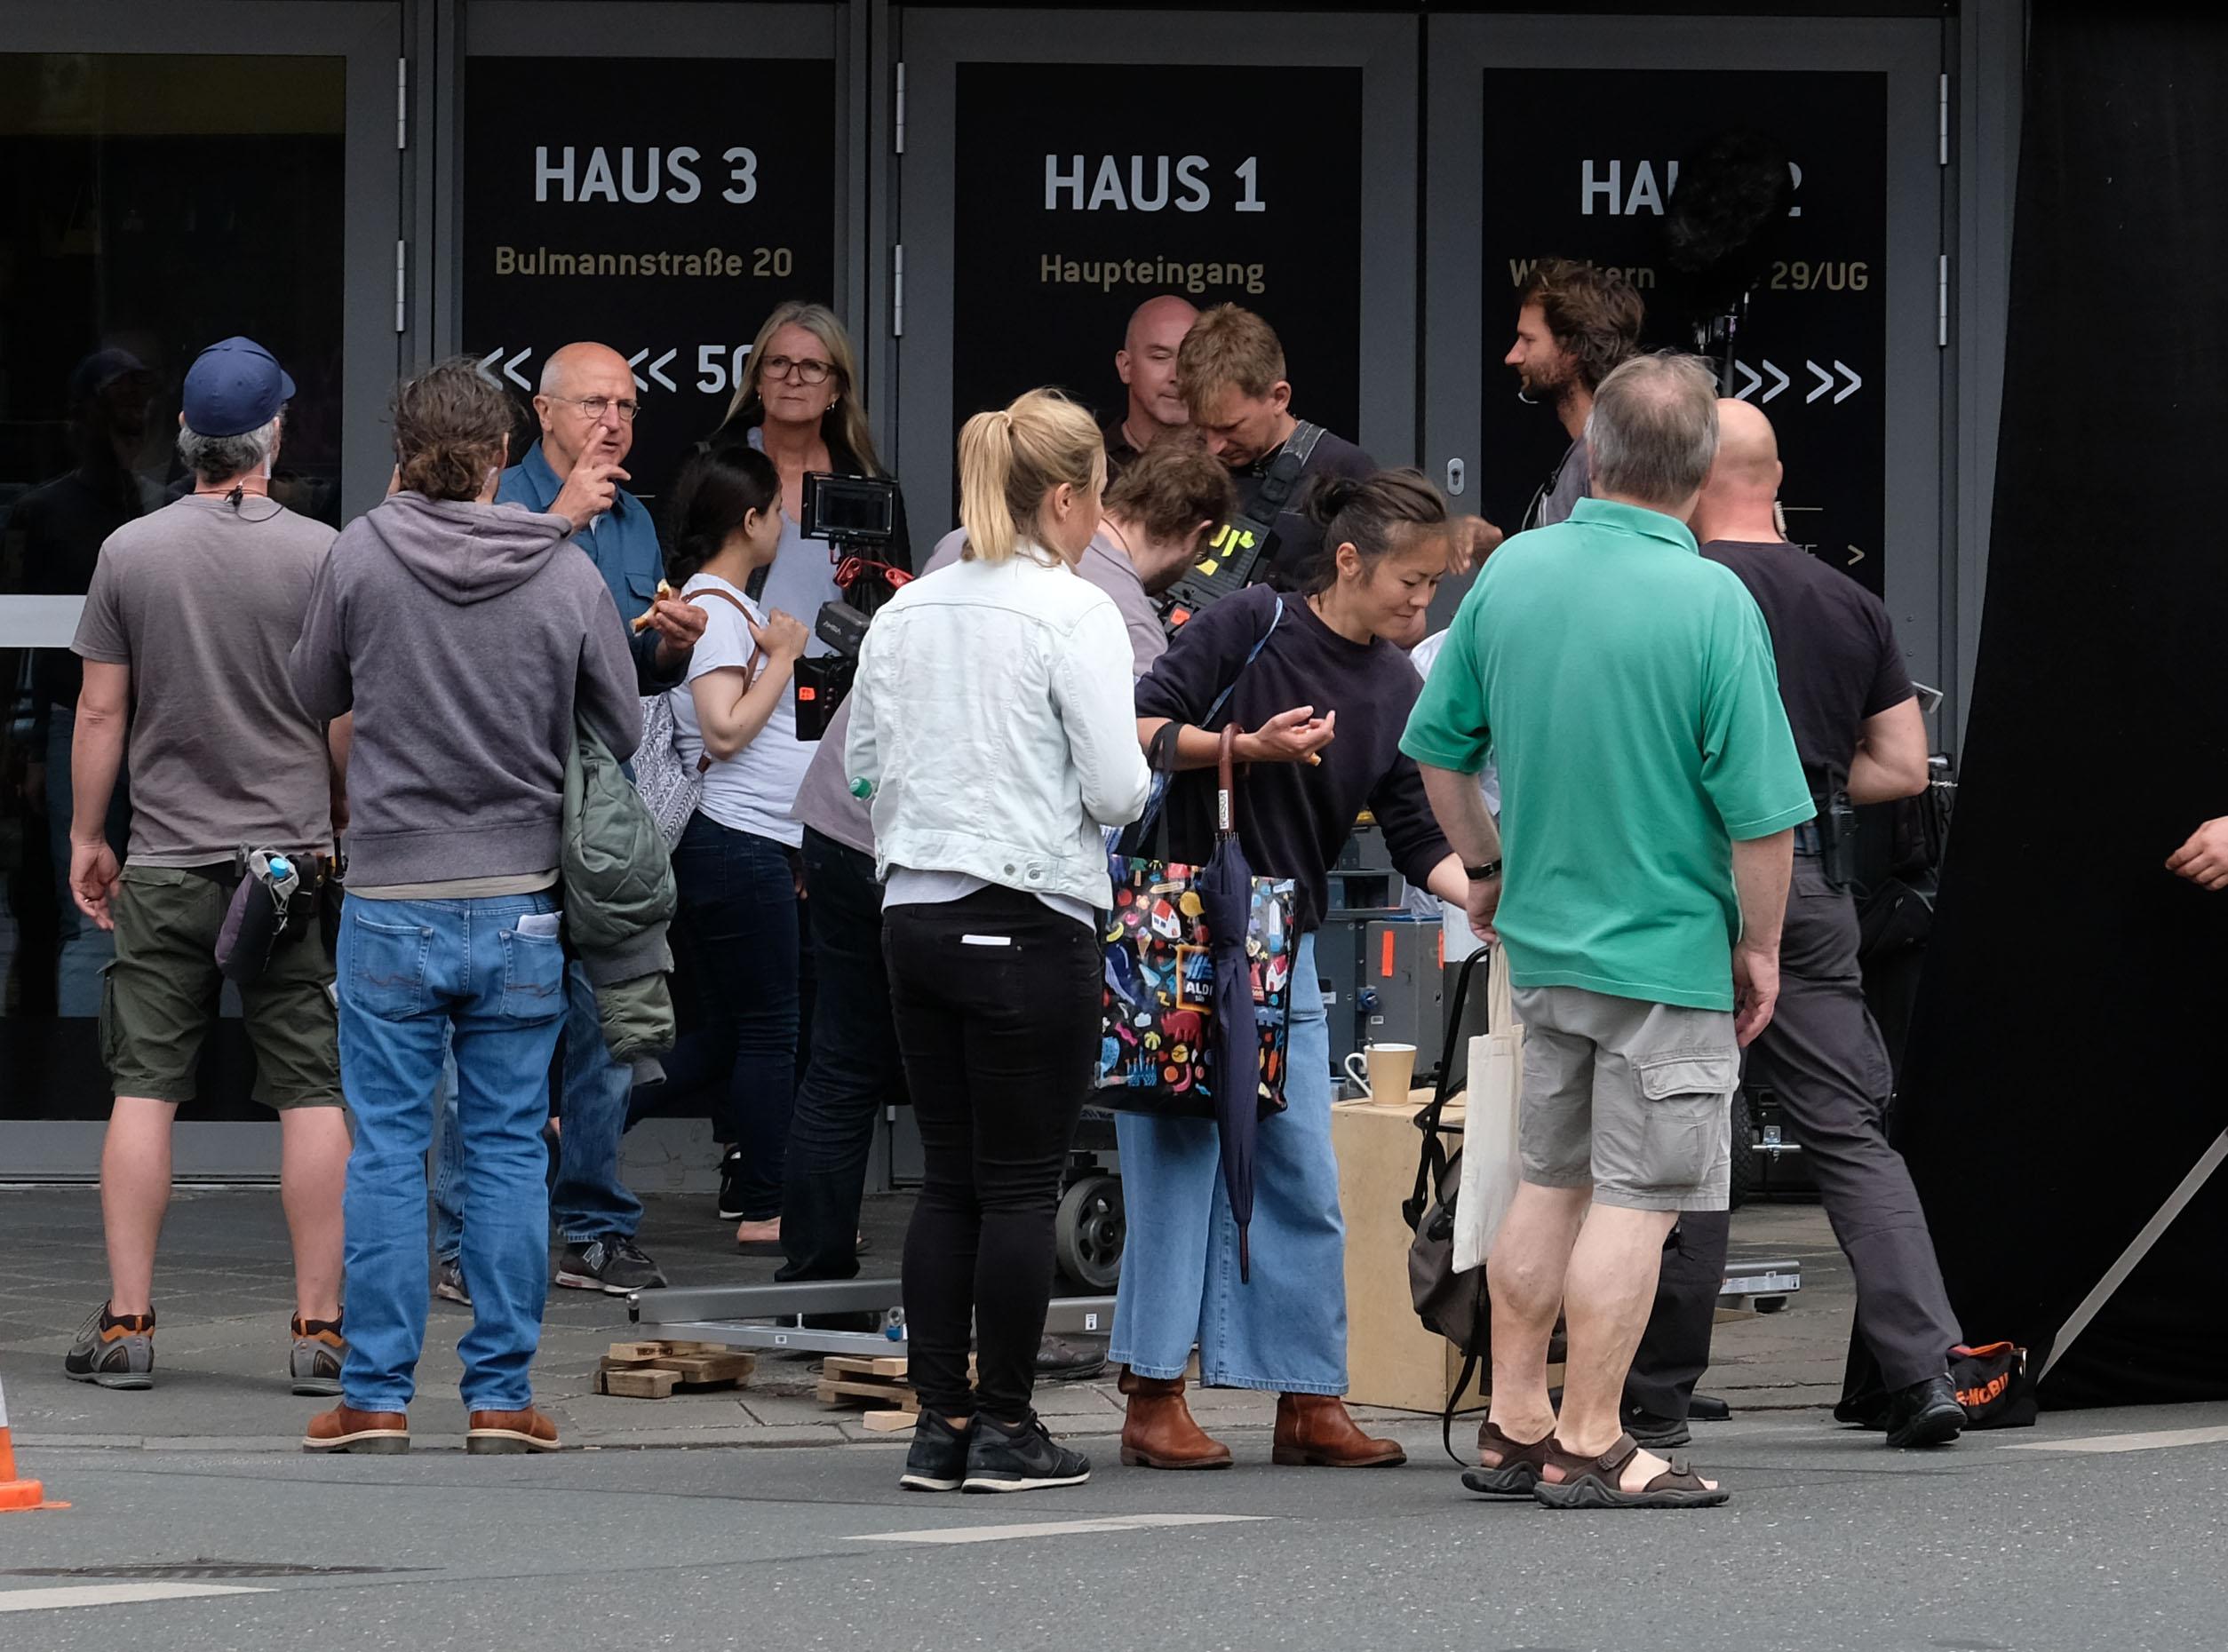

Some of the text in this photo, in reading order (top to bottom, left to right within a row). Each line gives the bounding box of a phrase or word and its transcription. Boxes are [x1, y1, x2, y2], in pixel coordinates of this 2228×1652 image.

[536, 147, 757, 203] HAUS 3
[1046, 155, 1265, 211] HAUS 1
[497, 247, 792, 276] Bulmannstraße 20
[1042, 255, 1265, 293] Haupteingang
[1771, 262, 1867, 290] 29/UG
[1185, 981, 1213, 997] ALDI
